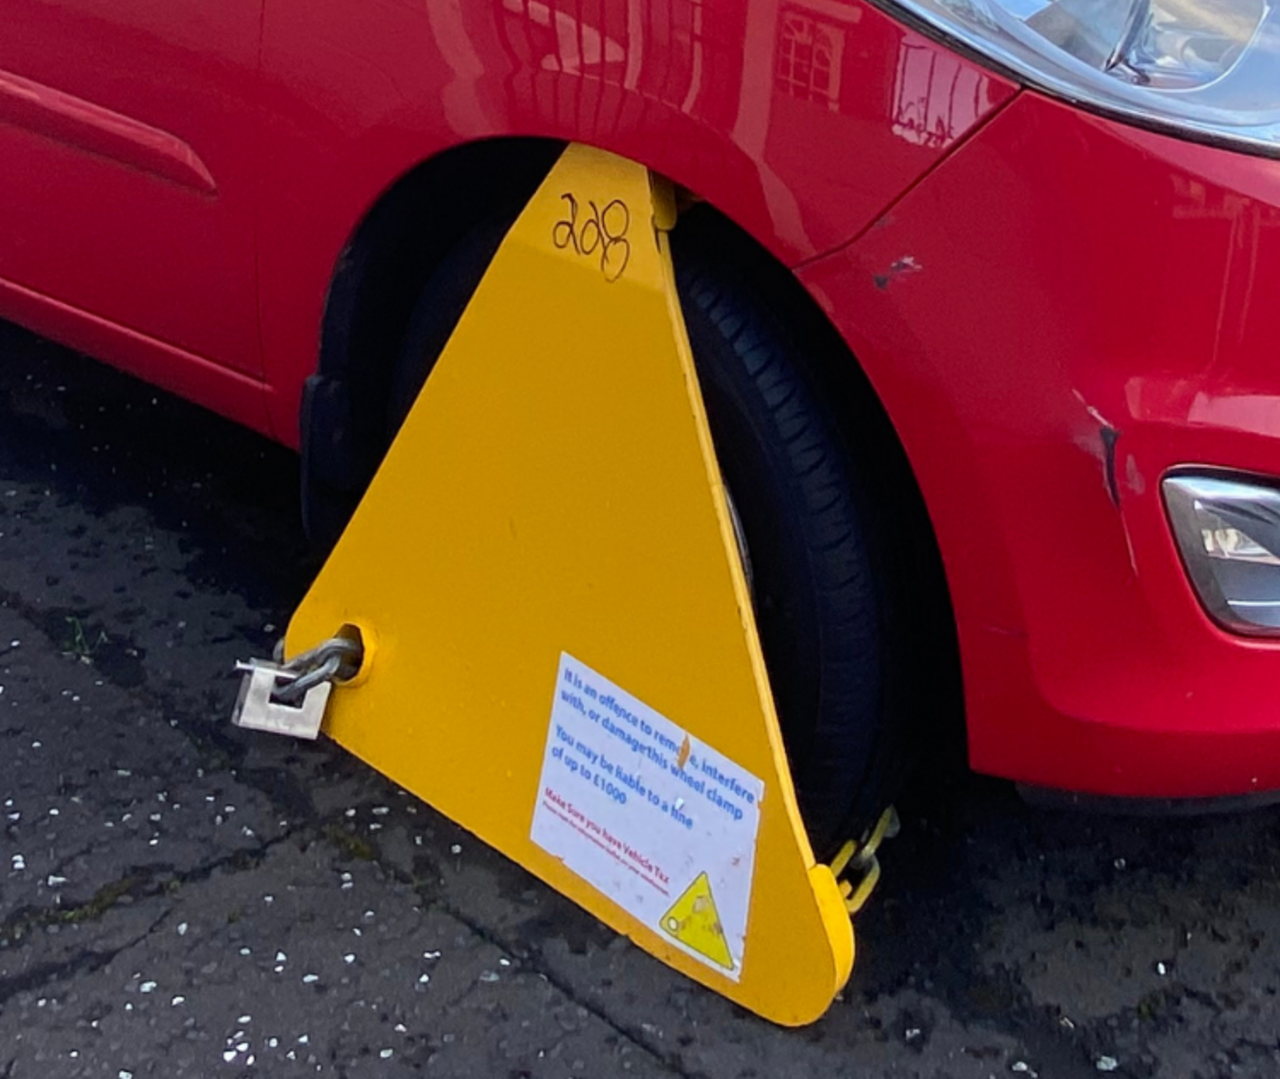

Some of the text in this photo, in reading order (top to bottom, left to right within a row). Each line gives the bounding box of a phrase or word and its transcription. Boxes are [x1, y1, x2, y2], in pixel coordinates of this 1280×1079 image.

[551, 746, 627, 805] of up to £1000
[556, 723, 694, 831] You may be liable to a fine
[561, 689, 586, 716] with,
[588, 709, 601, 723] or
[670, 762, 706, 795] wheel
[706, 787, 744, 821] clamp
[565, 667, 755, 805] It is an offence to reme, interfere
[545, 786, 566, 810] Make
[654, 865, 670, 885] Tax
